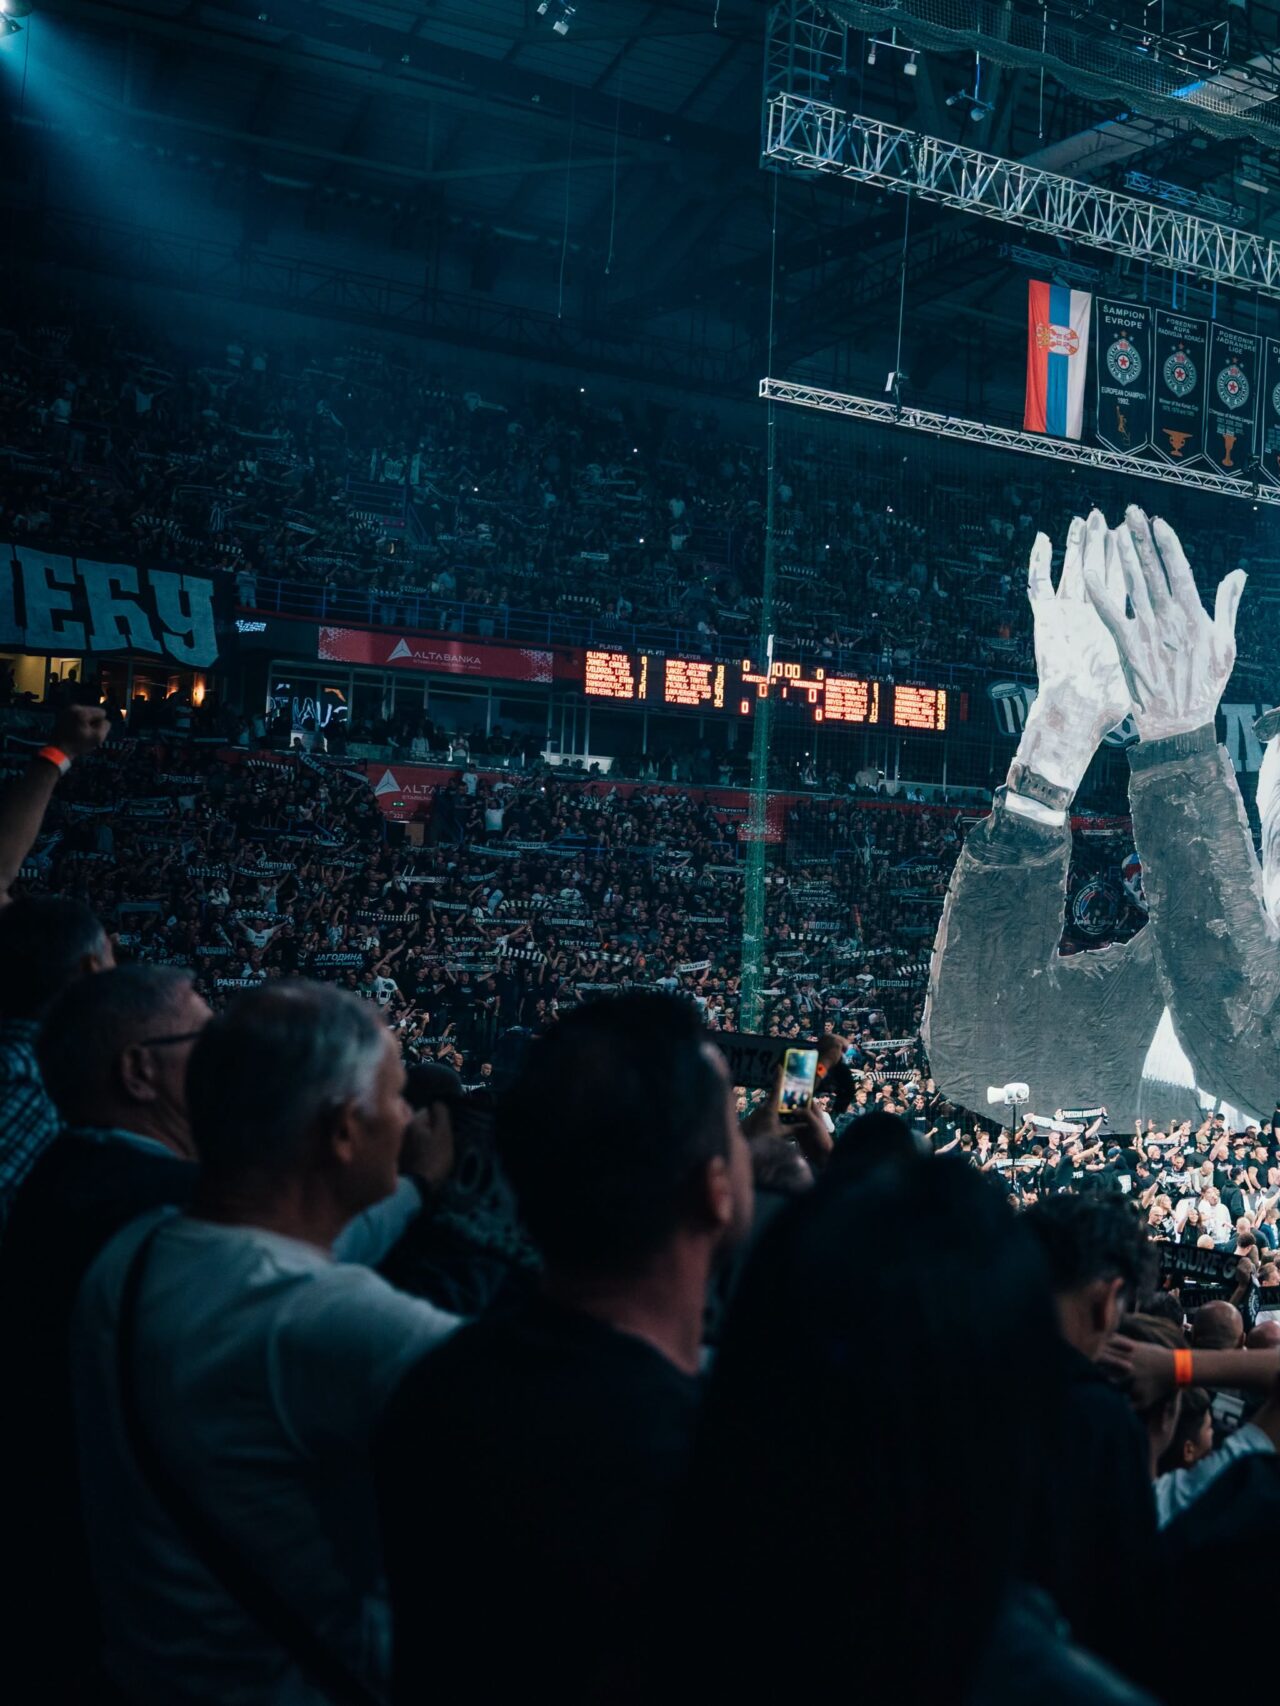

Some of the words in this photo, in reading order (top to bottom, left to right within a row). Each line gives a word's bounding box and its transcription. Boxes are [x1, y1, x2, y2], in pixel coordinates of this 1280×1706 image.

[1103, 304, 1145, 320] ŠAMPION
[1105, 315, 1143, 330] EVROPE
[1219, 330, 1254, 346] POBEDNIK
[1228, 346, 1243, 355] LIGE
[1101, 386, 1124, 397] EUROPEAN
[413, 650, 482, 665] ALTABANKA
